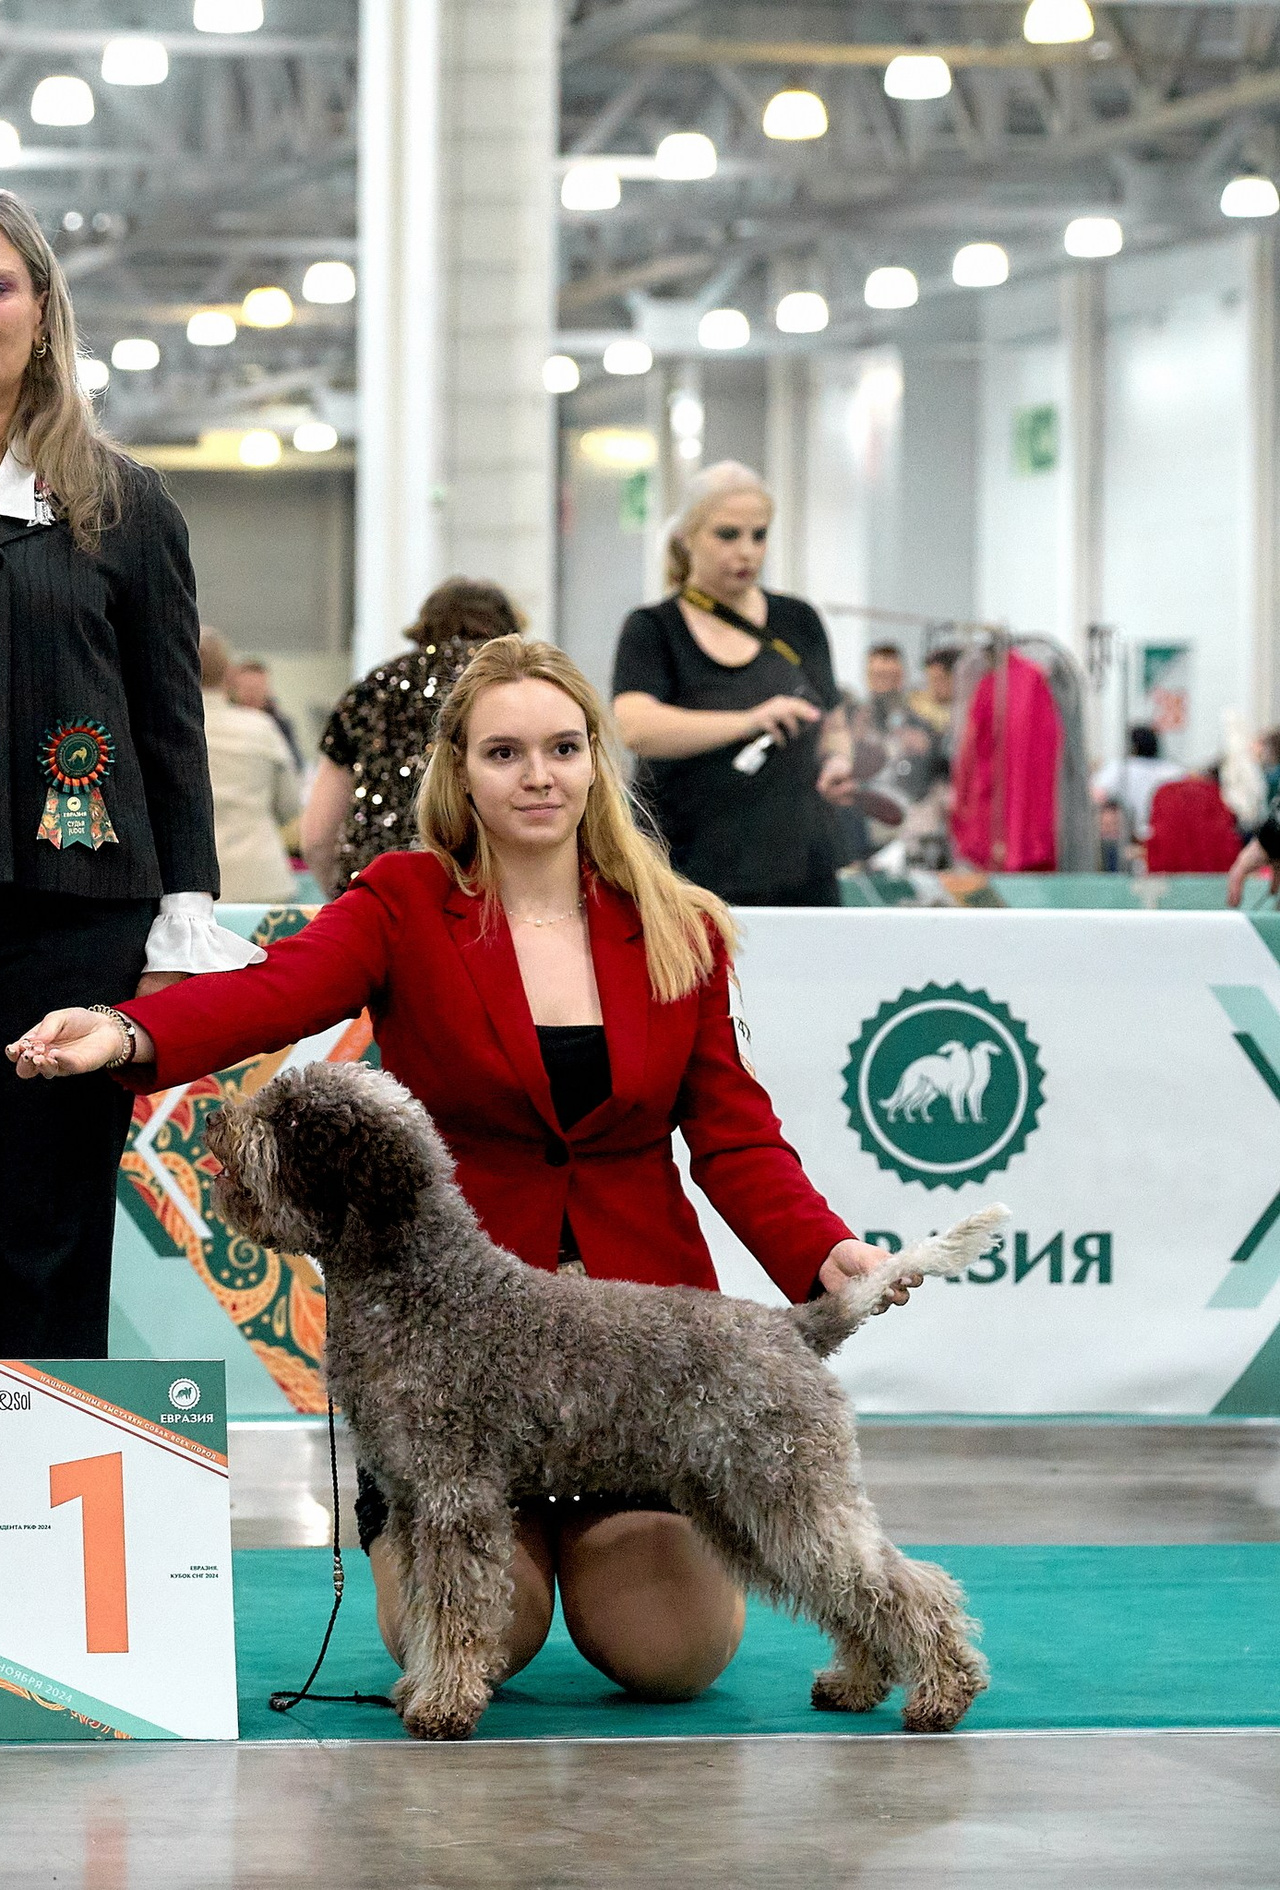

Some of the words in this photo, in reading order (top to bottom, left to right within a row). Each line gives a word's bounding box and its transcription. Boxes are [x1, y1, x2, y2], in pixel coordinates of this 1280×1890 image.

[40, 1375, 101, 1407] НАЦИОНАЛЬНЫЕ
[102, 1404, 143, 1426] ВЫСТАВКИ
[144, 1422, 168, 1438] СОБАК
[170, 1435, 190, 1447] ВСЕХ
[190, 1445, 217, 1460] ПОРОД
[160, 1413, 214, 1424] ЕВРАЗИЯ
[49, 1451, 129, 1653] 1
[44, 1684, 73, 1703] 2024
